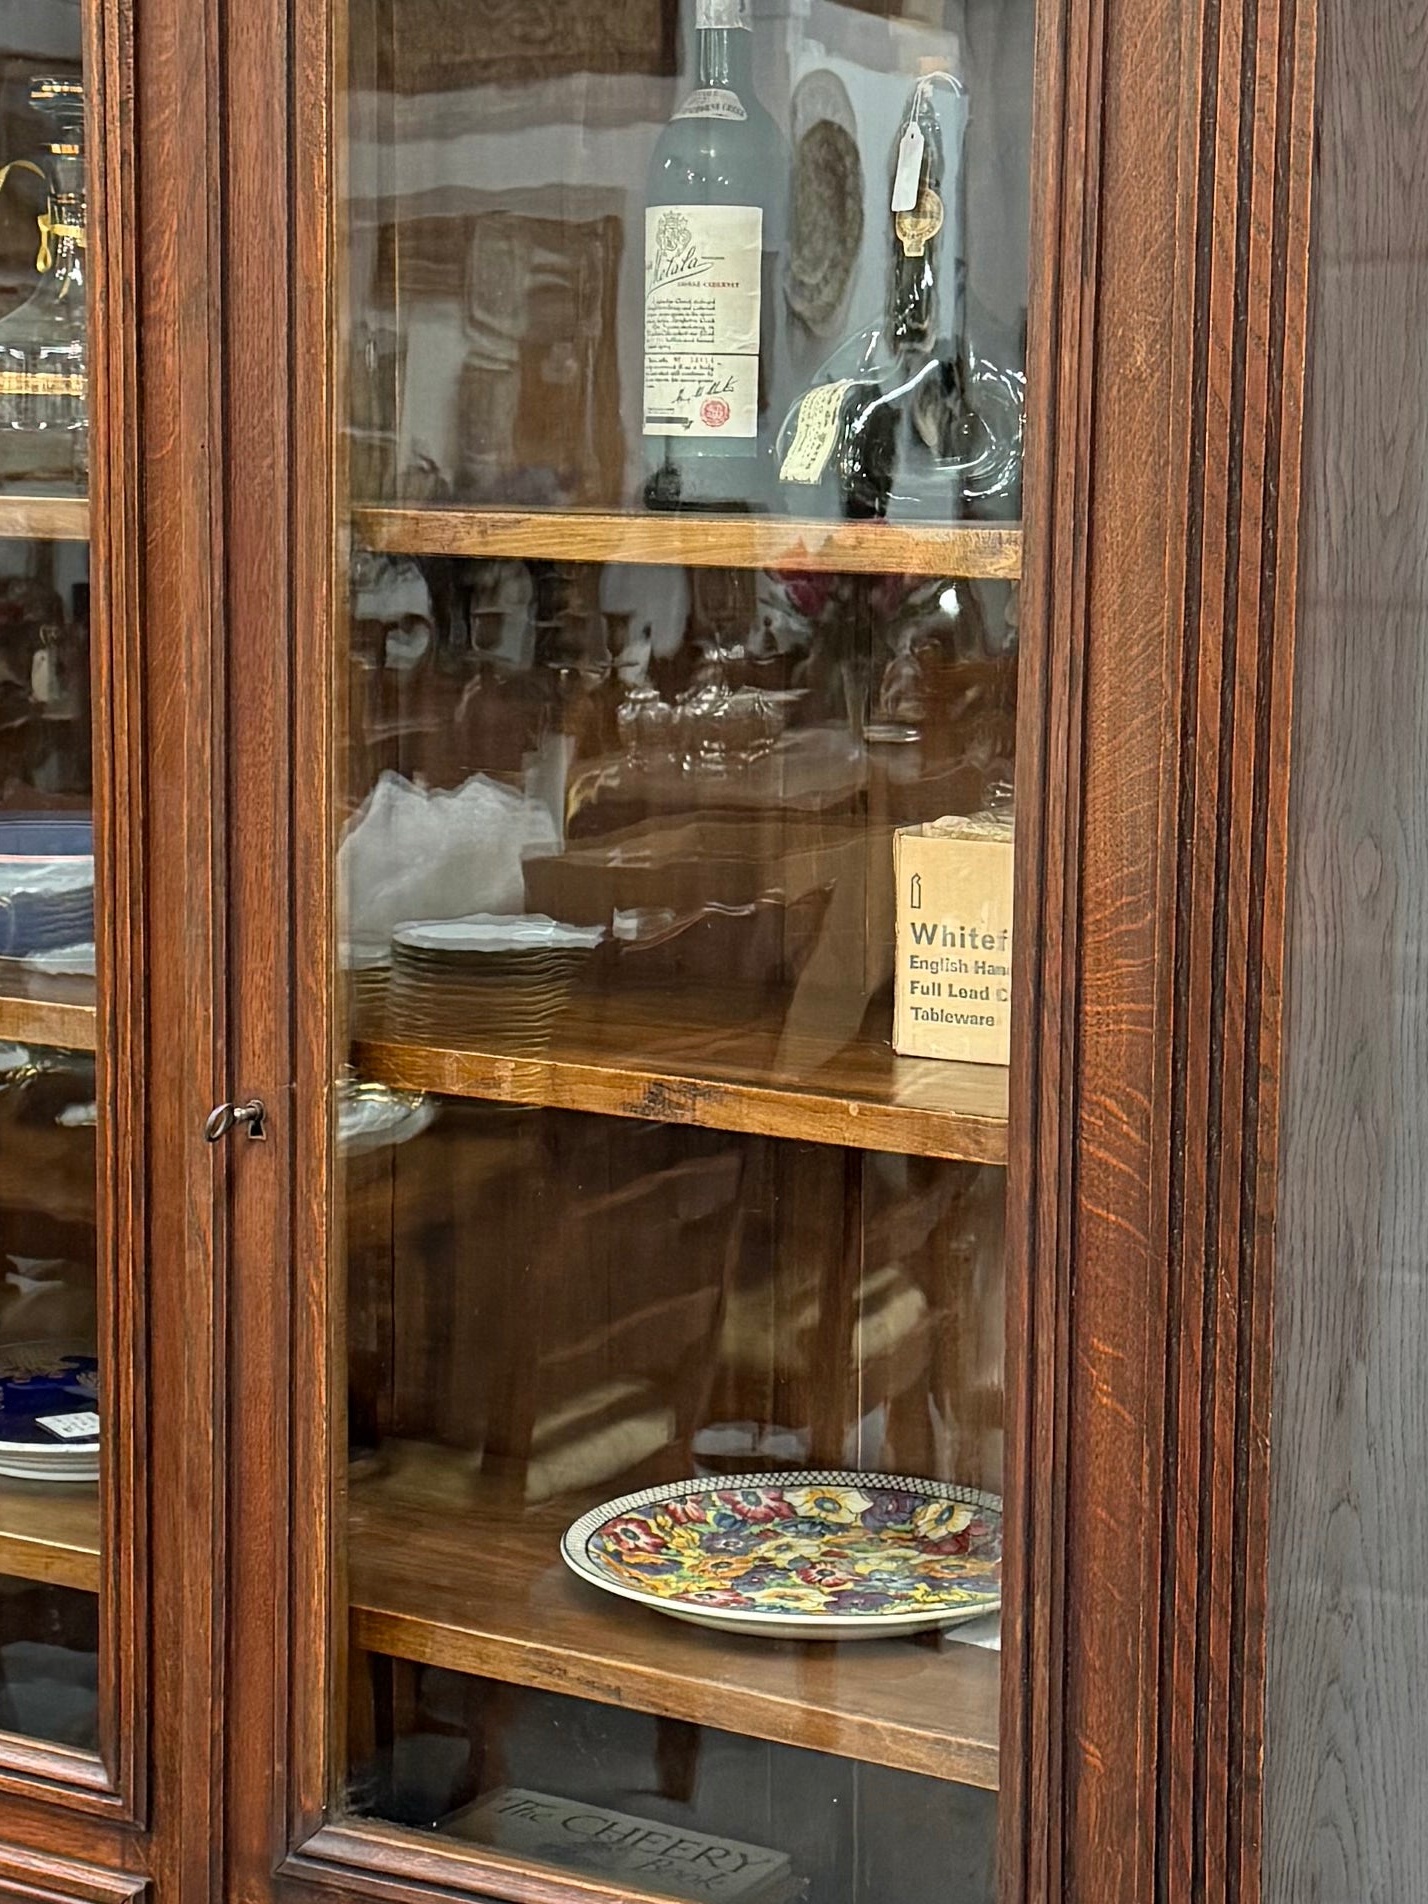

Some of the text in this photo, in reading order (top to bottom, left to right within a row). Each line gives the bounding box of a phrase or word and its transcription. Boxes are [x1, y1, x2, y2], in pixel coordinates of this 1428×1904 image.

[909, 954, 969, 975] English
[909, 980, 942, 997] Full
[909, 1006, 996, 1027] Tableware
[561, 1814, 771, 1873] CHEERY
